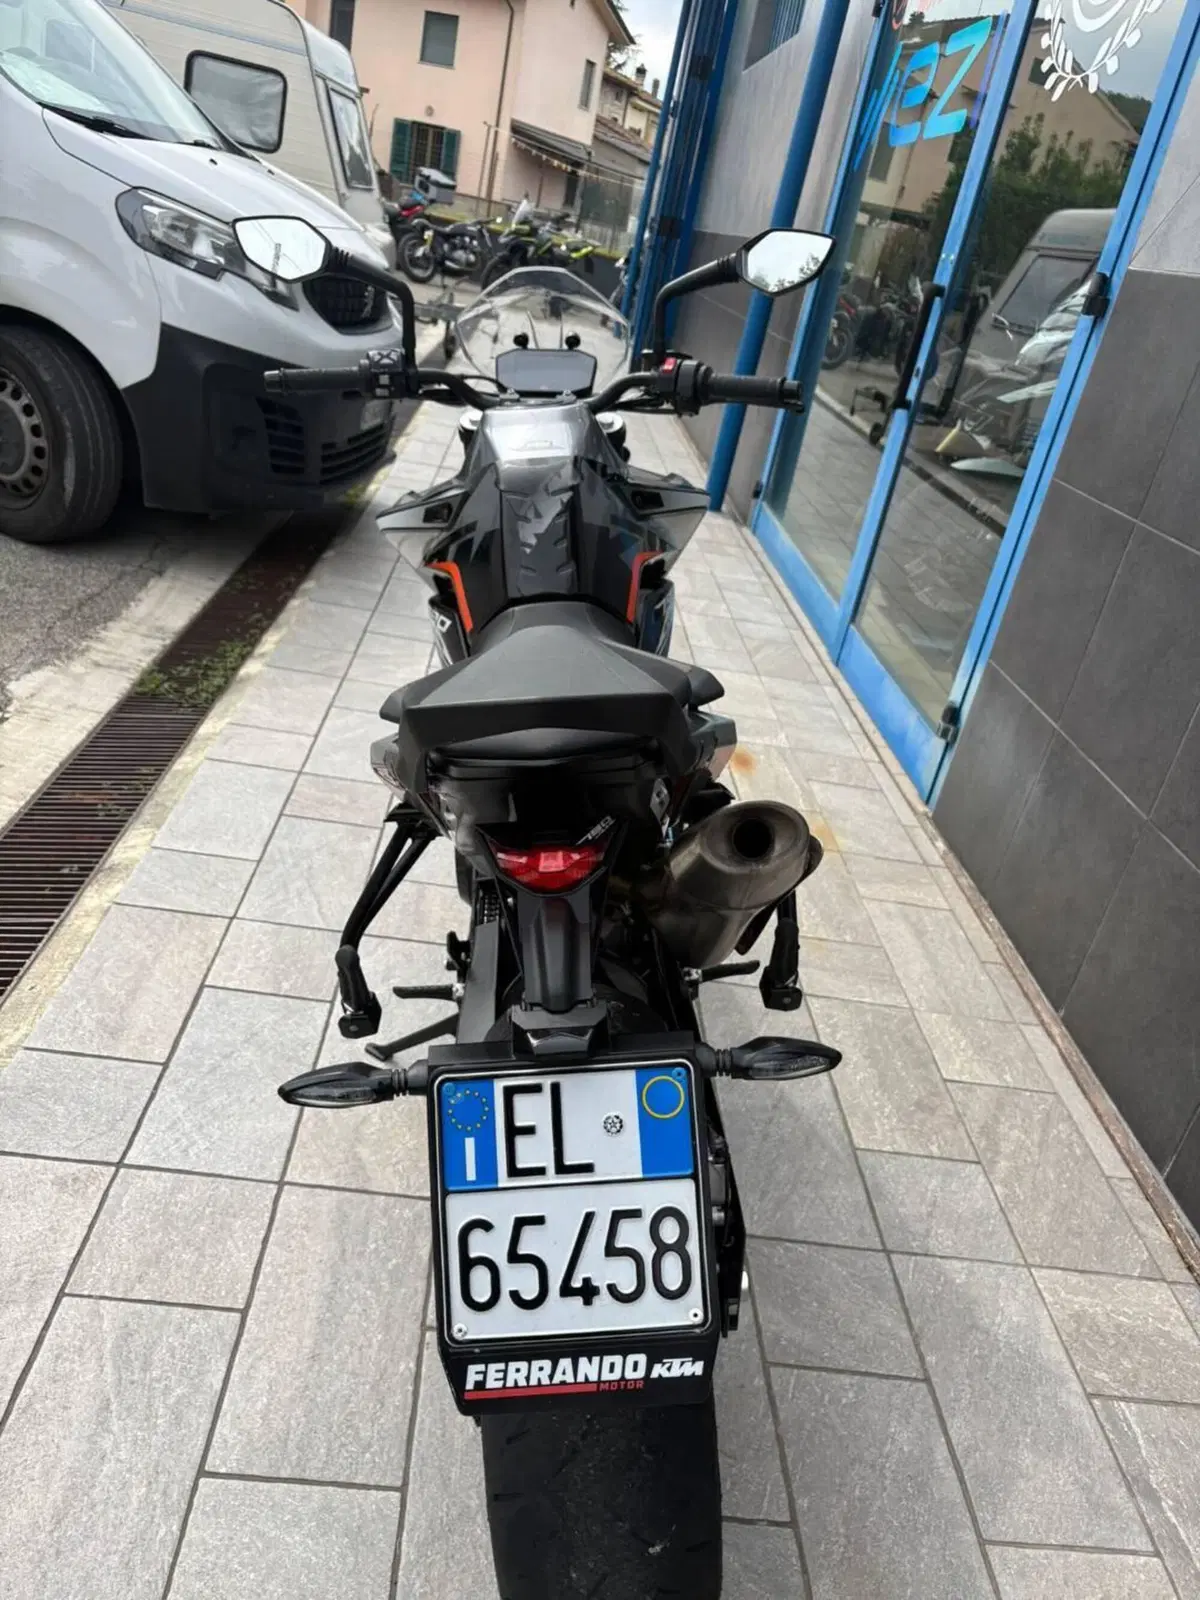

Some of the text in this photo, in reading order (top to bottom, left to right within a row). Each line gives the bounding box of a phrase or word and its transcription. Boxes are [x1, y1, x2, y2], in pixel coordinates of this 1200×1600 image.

[502, 1081, 595, 1178] EL
[457, 1205, 692, 1312] 65458
[464, 1352, 705, 1391] FERRANDO KTM
[599, 1379, 645, 1392] MOTOR
